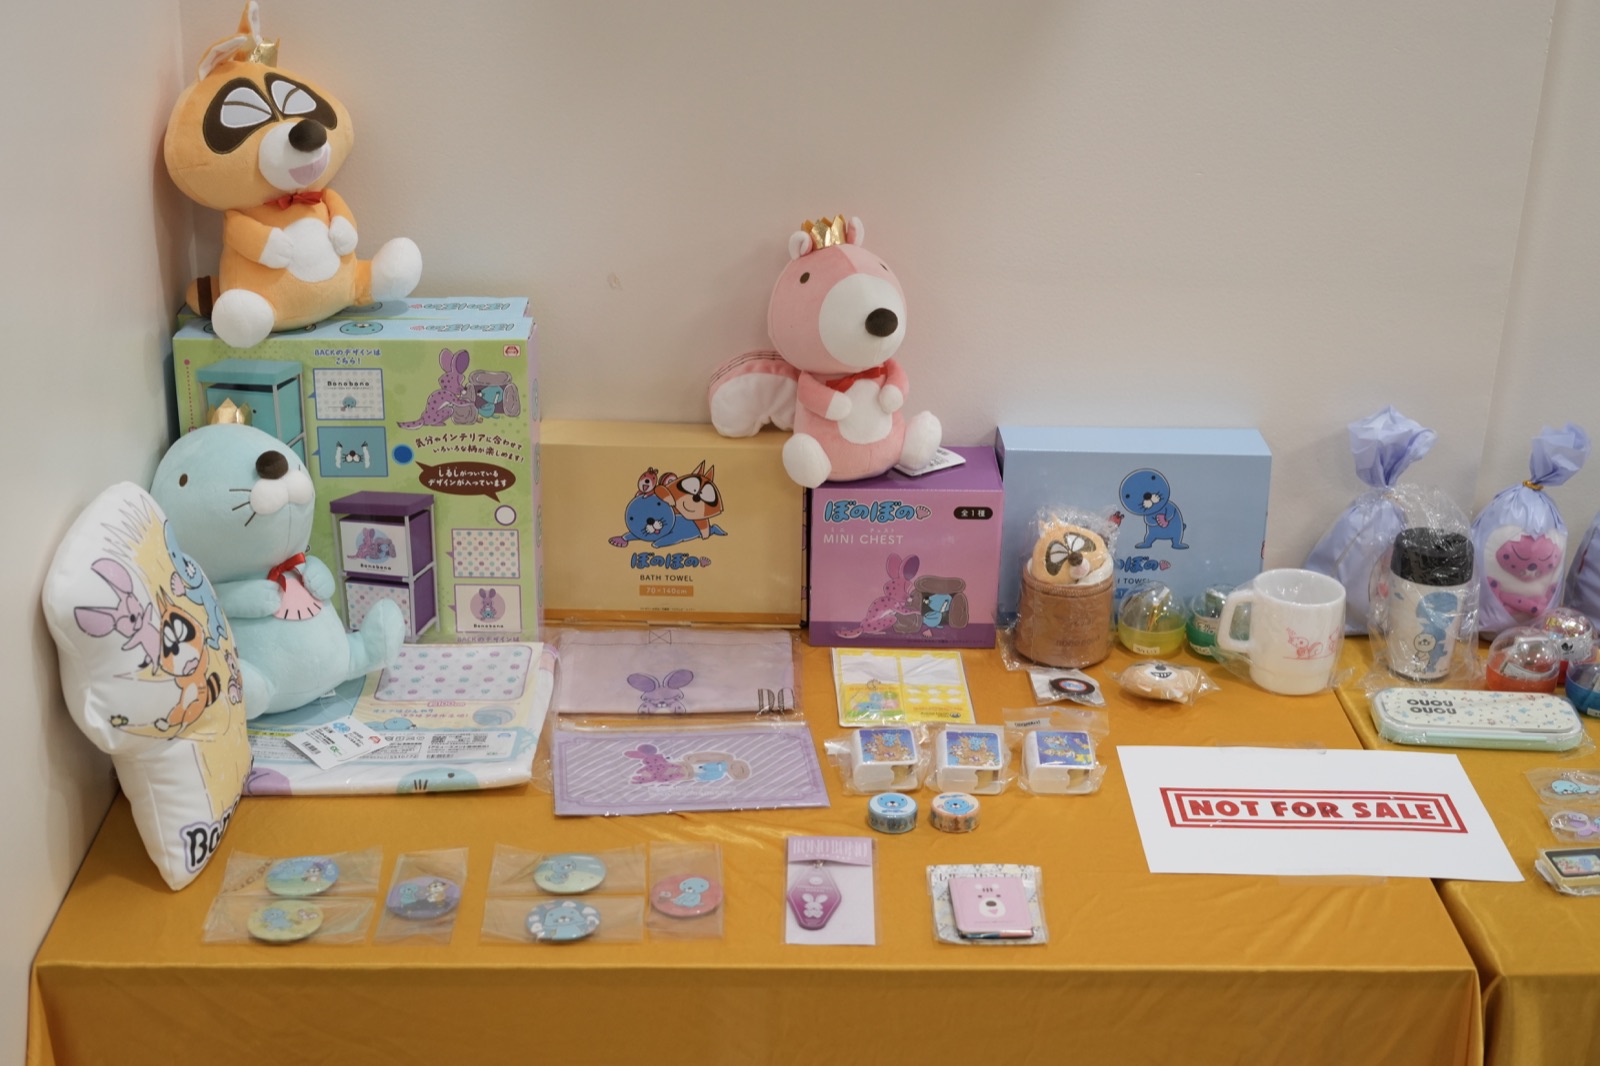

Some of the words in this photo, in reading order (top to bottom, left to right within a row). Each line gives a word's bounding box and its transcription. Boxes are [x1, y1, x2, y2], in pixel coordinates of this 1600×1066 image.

[438, 467, 499, 478] しるしがついている
[427, 479, 508, 488] デザインが入っています
[824, 499, 915, 523] ぼのぼの
[823, 533, 854, 545] MINI
[859, 533, 904, 545] CHEST
[630, 551, 700, 570] ぼのぼの
[665, 574, 694, 583] TOWEL
[1188, 799, 1259, 817] NOT
[1270, 800, 1344, 819] FOR
[1351, 801, 1437, 820] SALE
